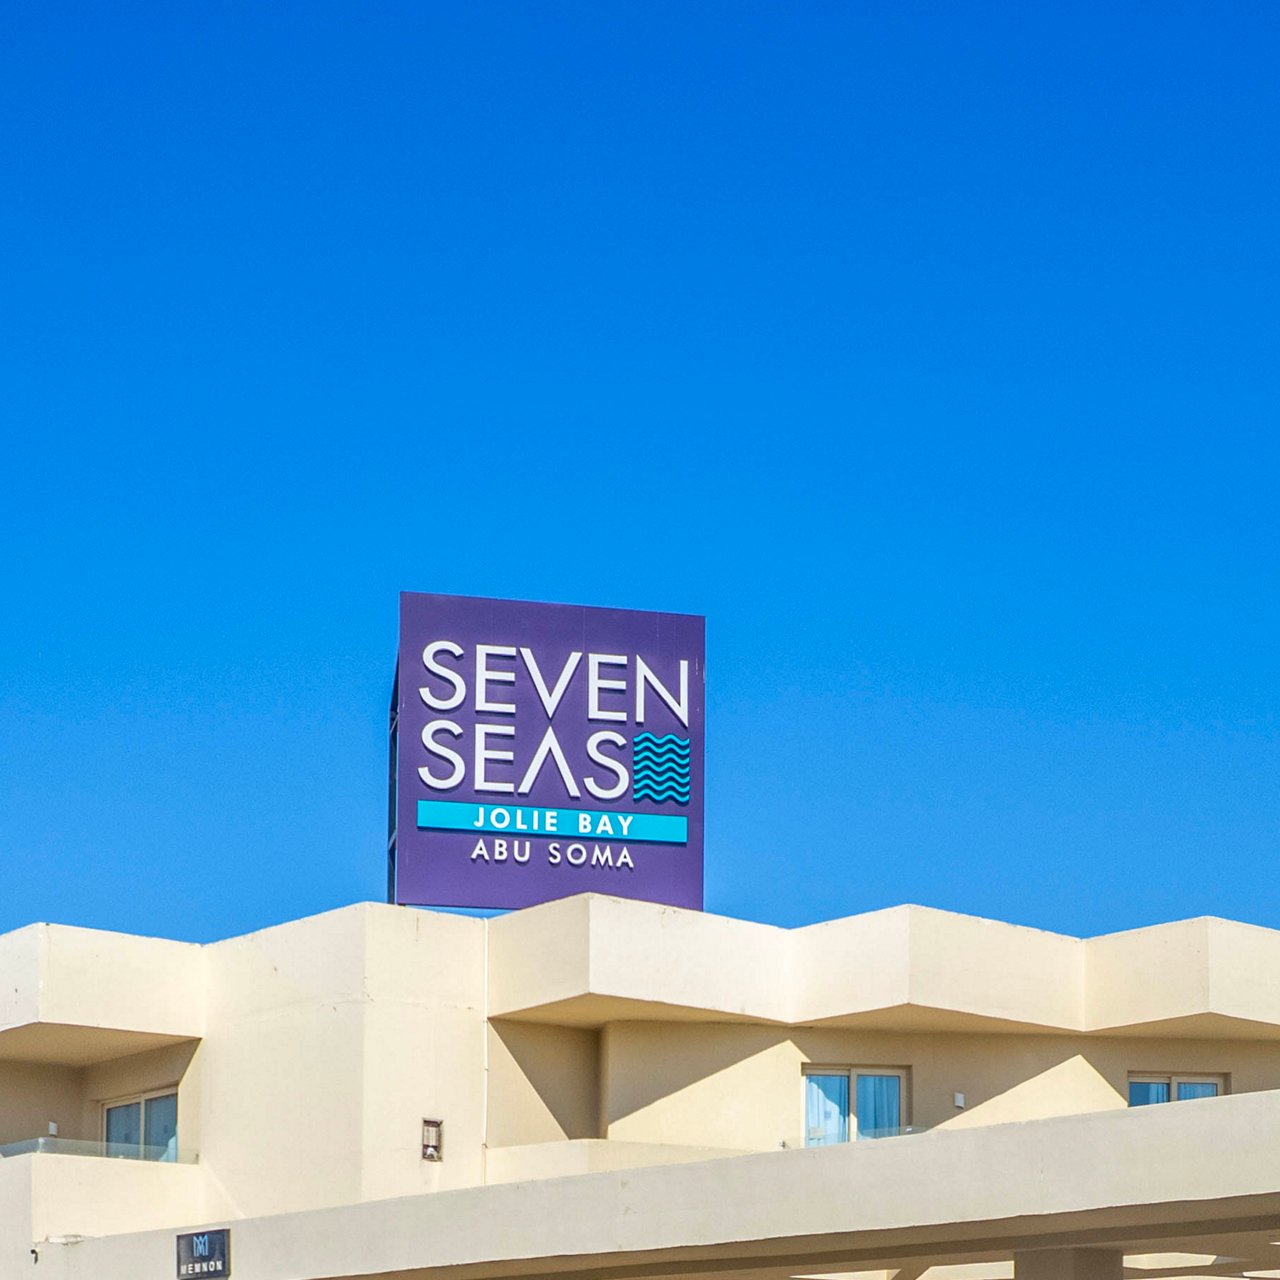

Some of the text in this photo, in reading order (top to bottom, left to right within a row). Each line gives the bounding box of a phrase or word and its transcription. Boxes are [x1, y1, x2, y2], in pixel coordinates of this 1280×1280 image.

[419, 640, 688, 728] SEVEN
[418, 720, 630, 799] SEAS
[474, 807, 633, 835] JOLIE BAY
[471, 839, 634, 868] ABU SOMA
